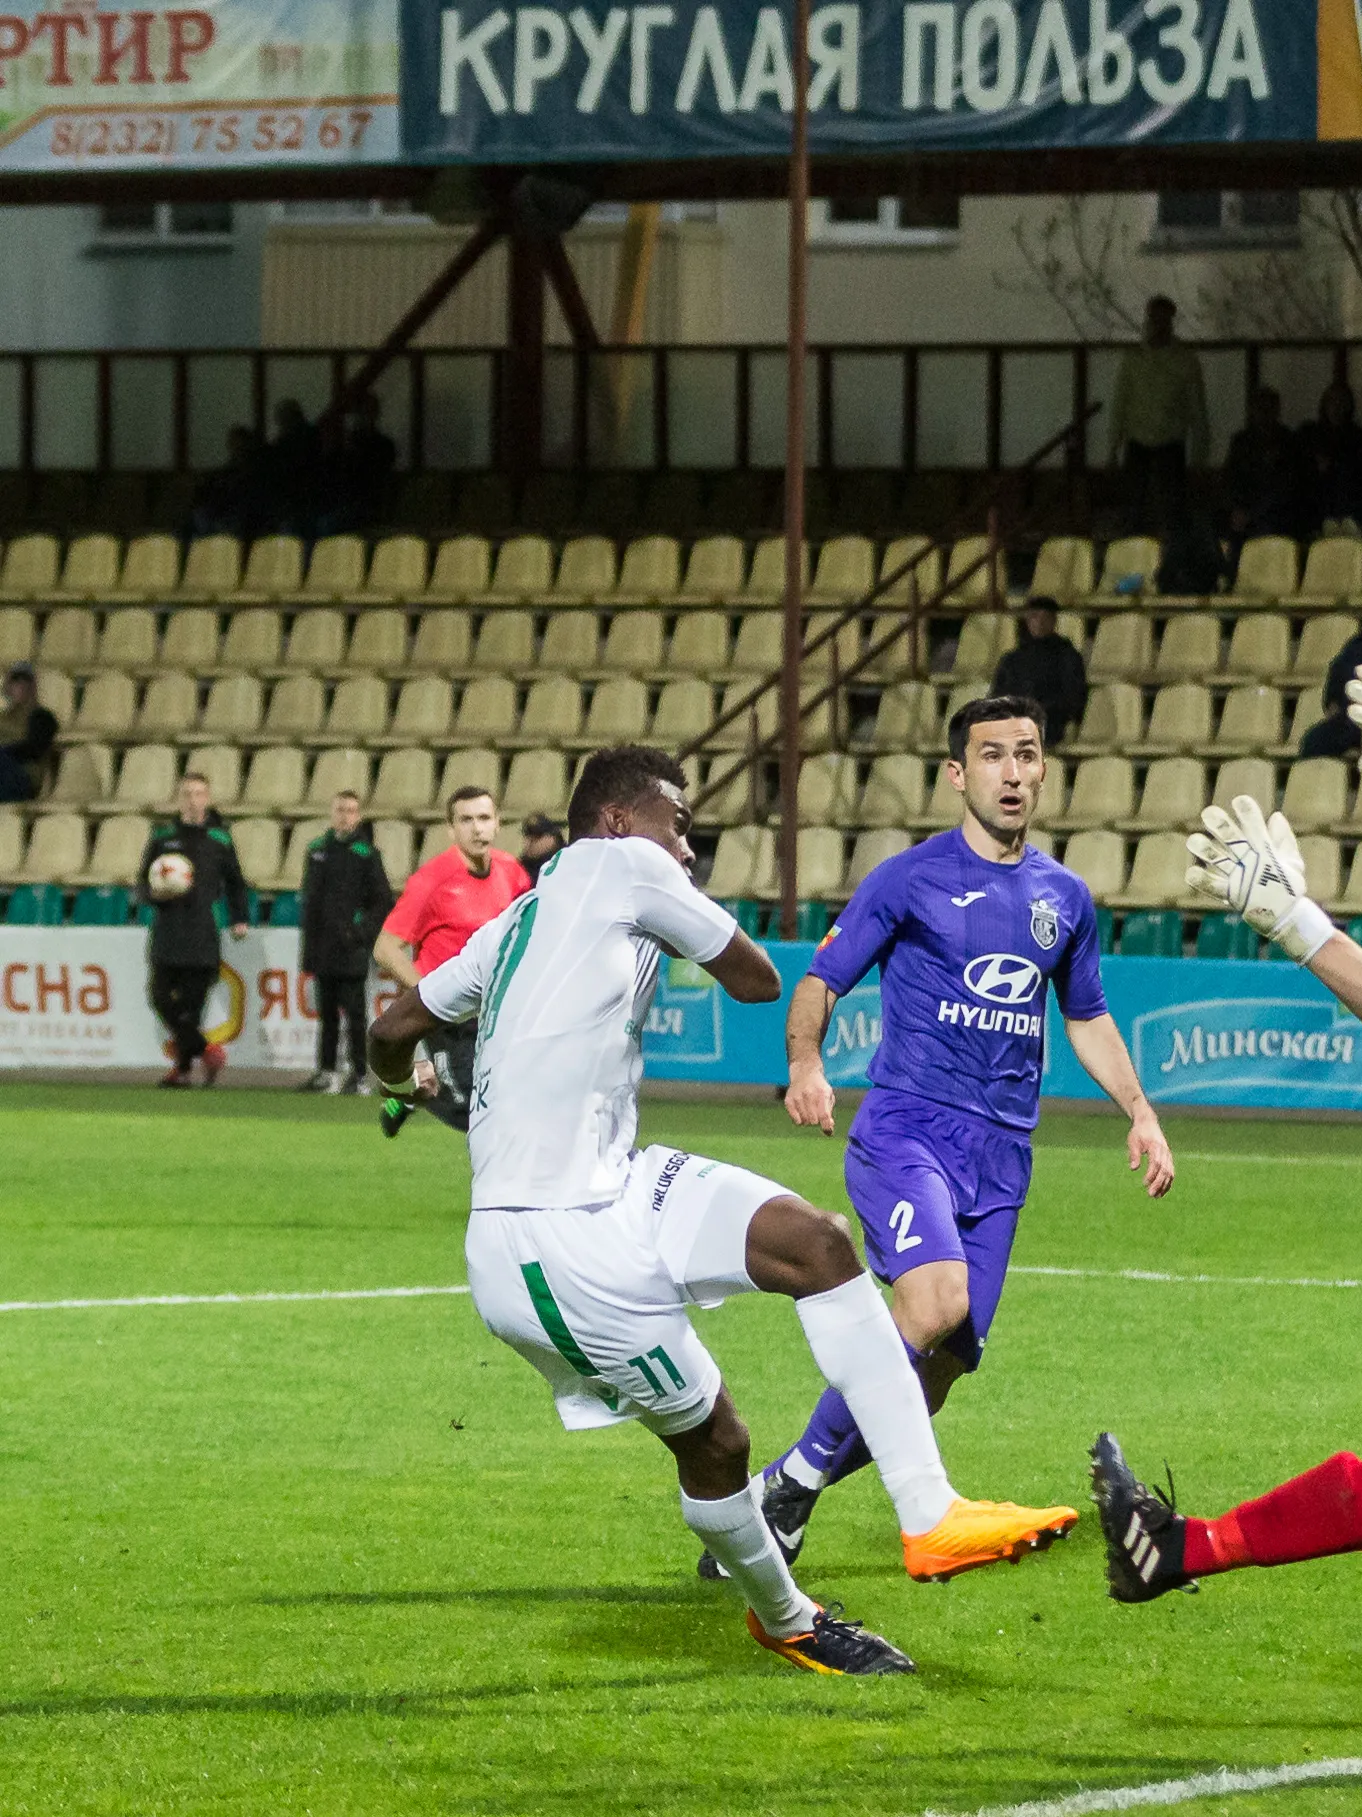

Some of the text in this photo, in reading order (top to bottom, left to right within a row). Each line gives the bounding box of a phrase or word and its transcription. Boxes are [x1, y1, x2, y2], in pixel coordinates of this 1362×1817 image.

[439, 0, 1270, 116] КРУГЛАЯ ПОЛЬЗА
[51, 110, 373, 161] 8(232) 75 52 67
[938, 1000, 1041, 1037] HYUNDAI
[1160, 1025, 1355, 1072] Минская
[889, 1200, 922, 1253] 2
[627, 1345, 687, 1398] 11
